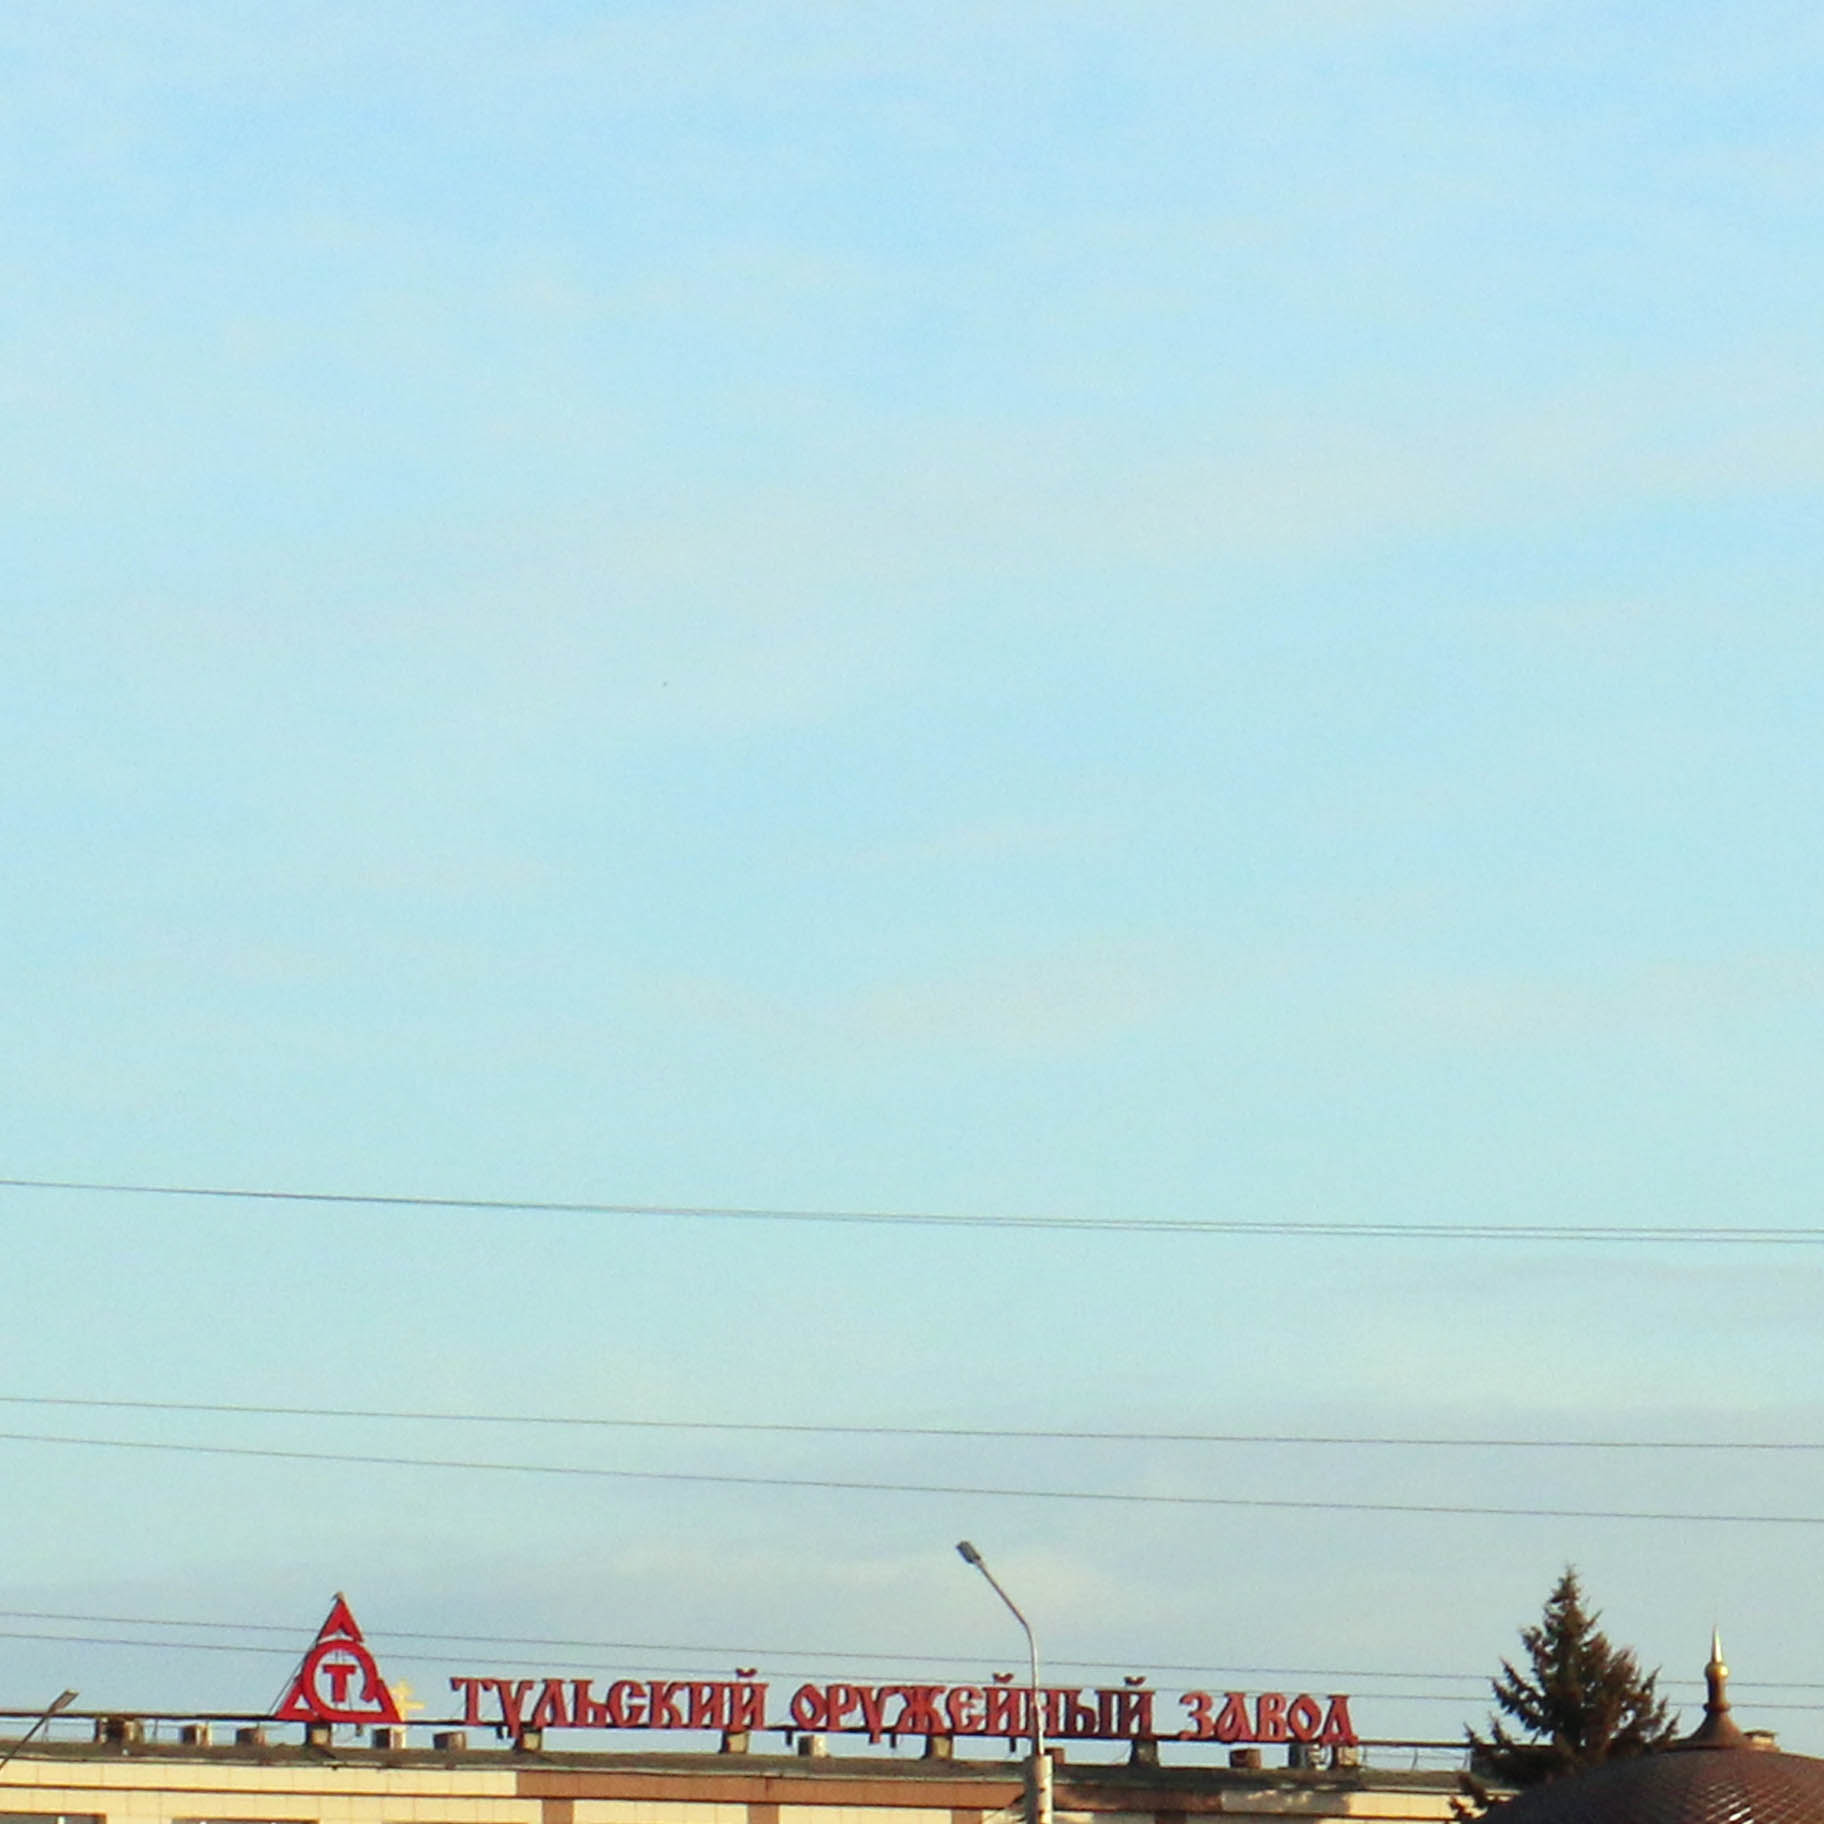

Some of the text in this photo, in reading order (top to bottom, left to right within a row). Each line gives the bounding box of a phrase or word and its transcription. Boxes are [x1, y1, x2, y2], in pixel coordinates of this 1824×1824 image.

[450, 1668, 1360, 1747] ТУЛЬСКИЙ ОРУЖЕЙНЫЙ ЗАВОД
